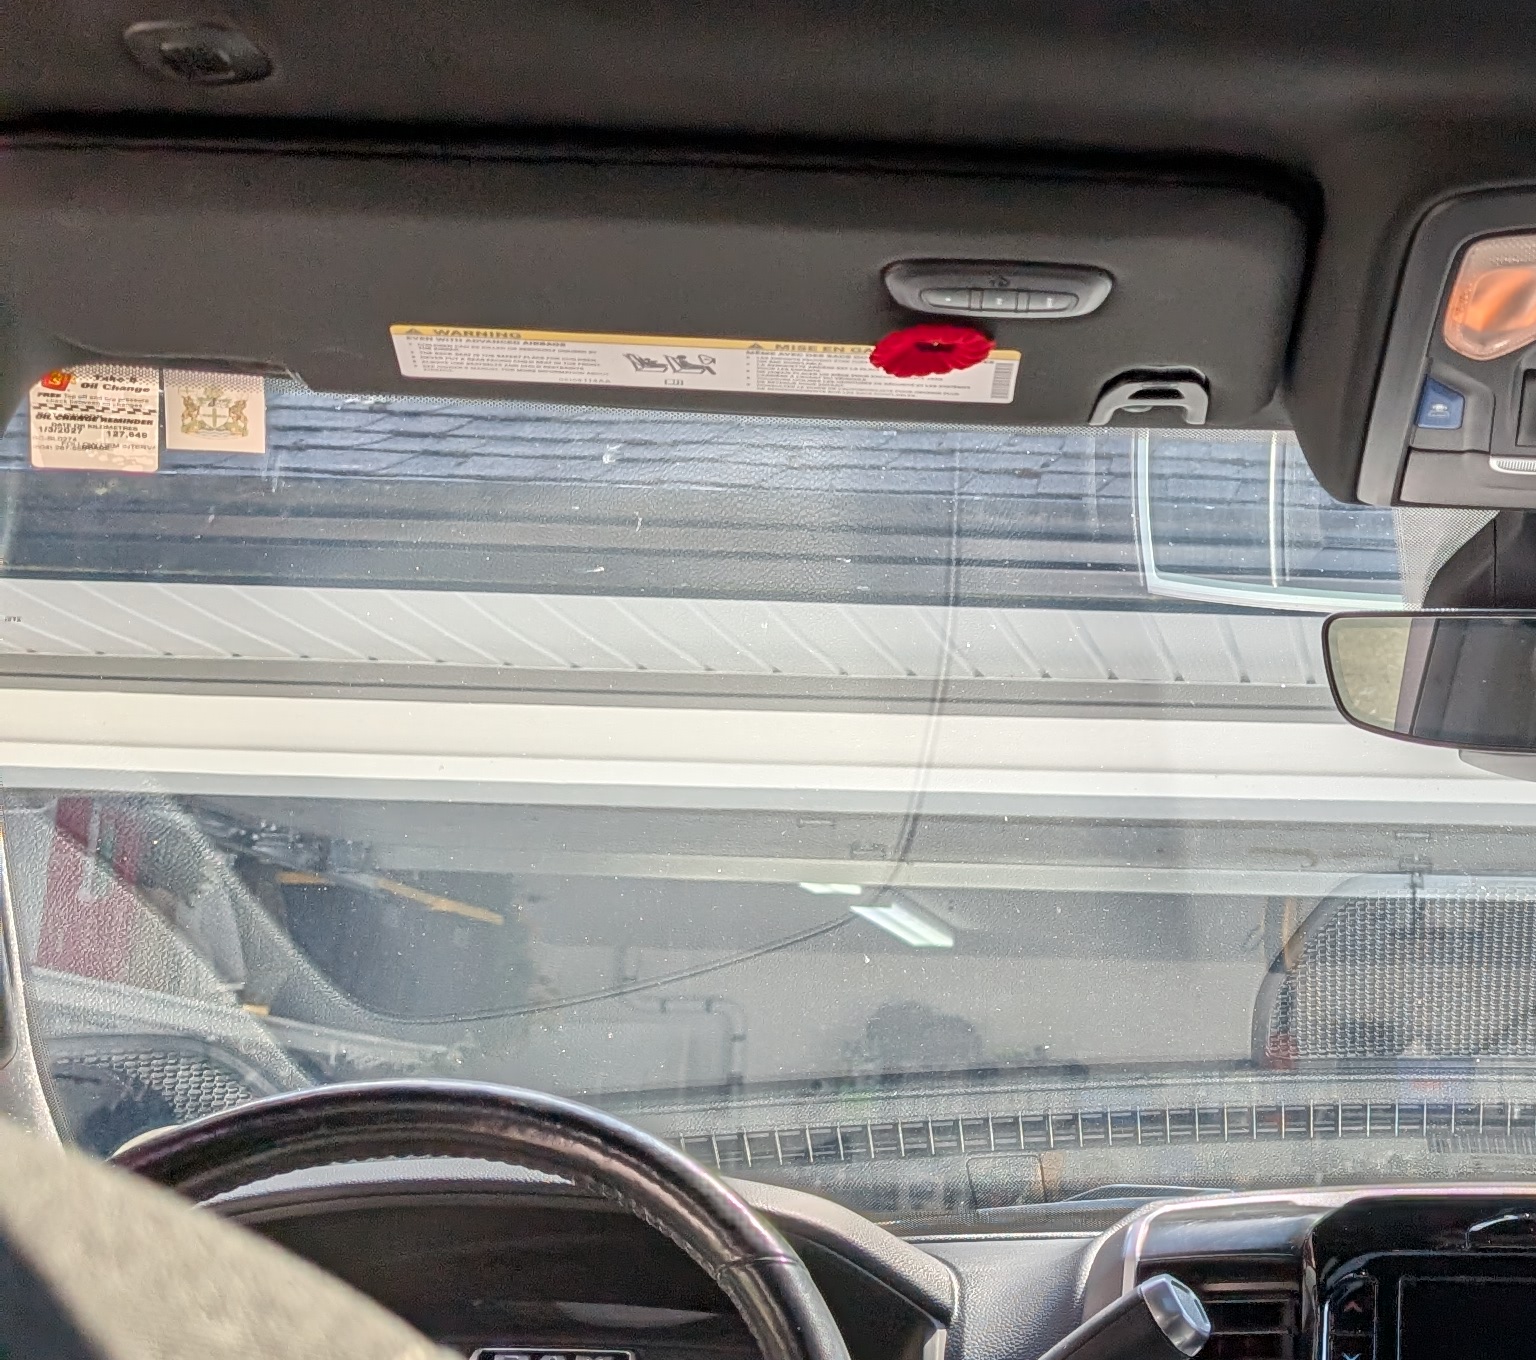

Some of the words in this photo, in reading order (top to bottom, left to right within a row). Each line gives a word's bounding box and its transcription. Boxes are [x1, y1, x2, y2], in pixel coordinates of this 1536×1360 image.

[433, 328, 522, 339] WARNING
[775, 343, 820, 352] MISE
[823, 345, 848, 353] EN
[80, 382, 98, 390] Oil
[103, 383, 150, 393] Change
[100, 417, 154, 426] REMINDER
